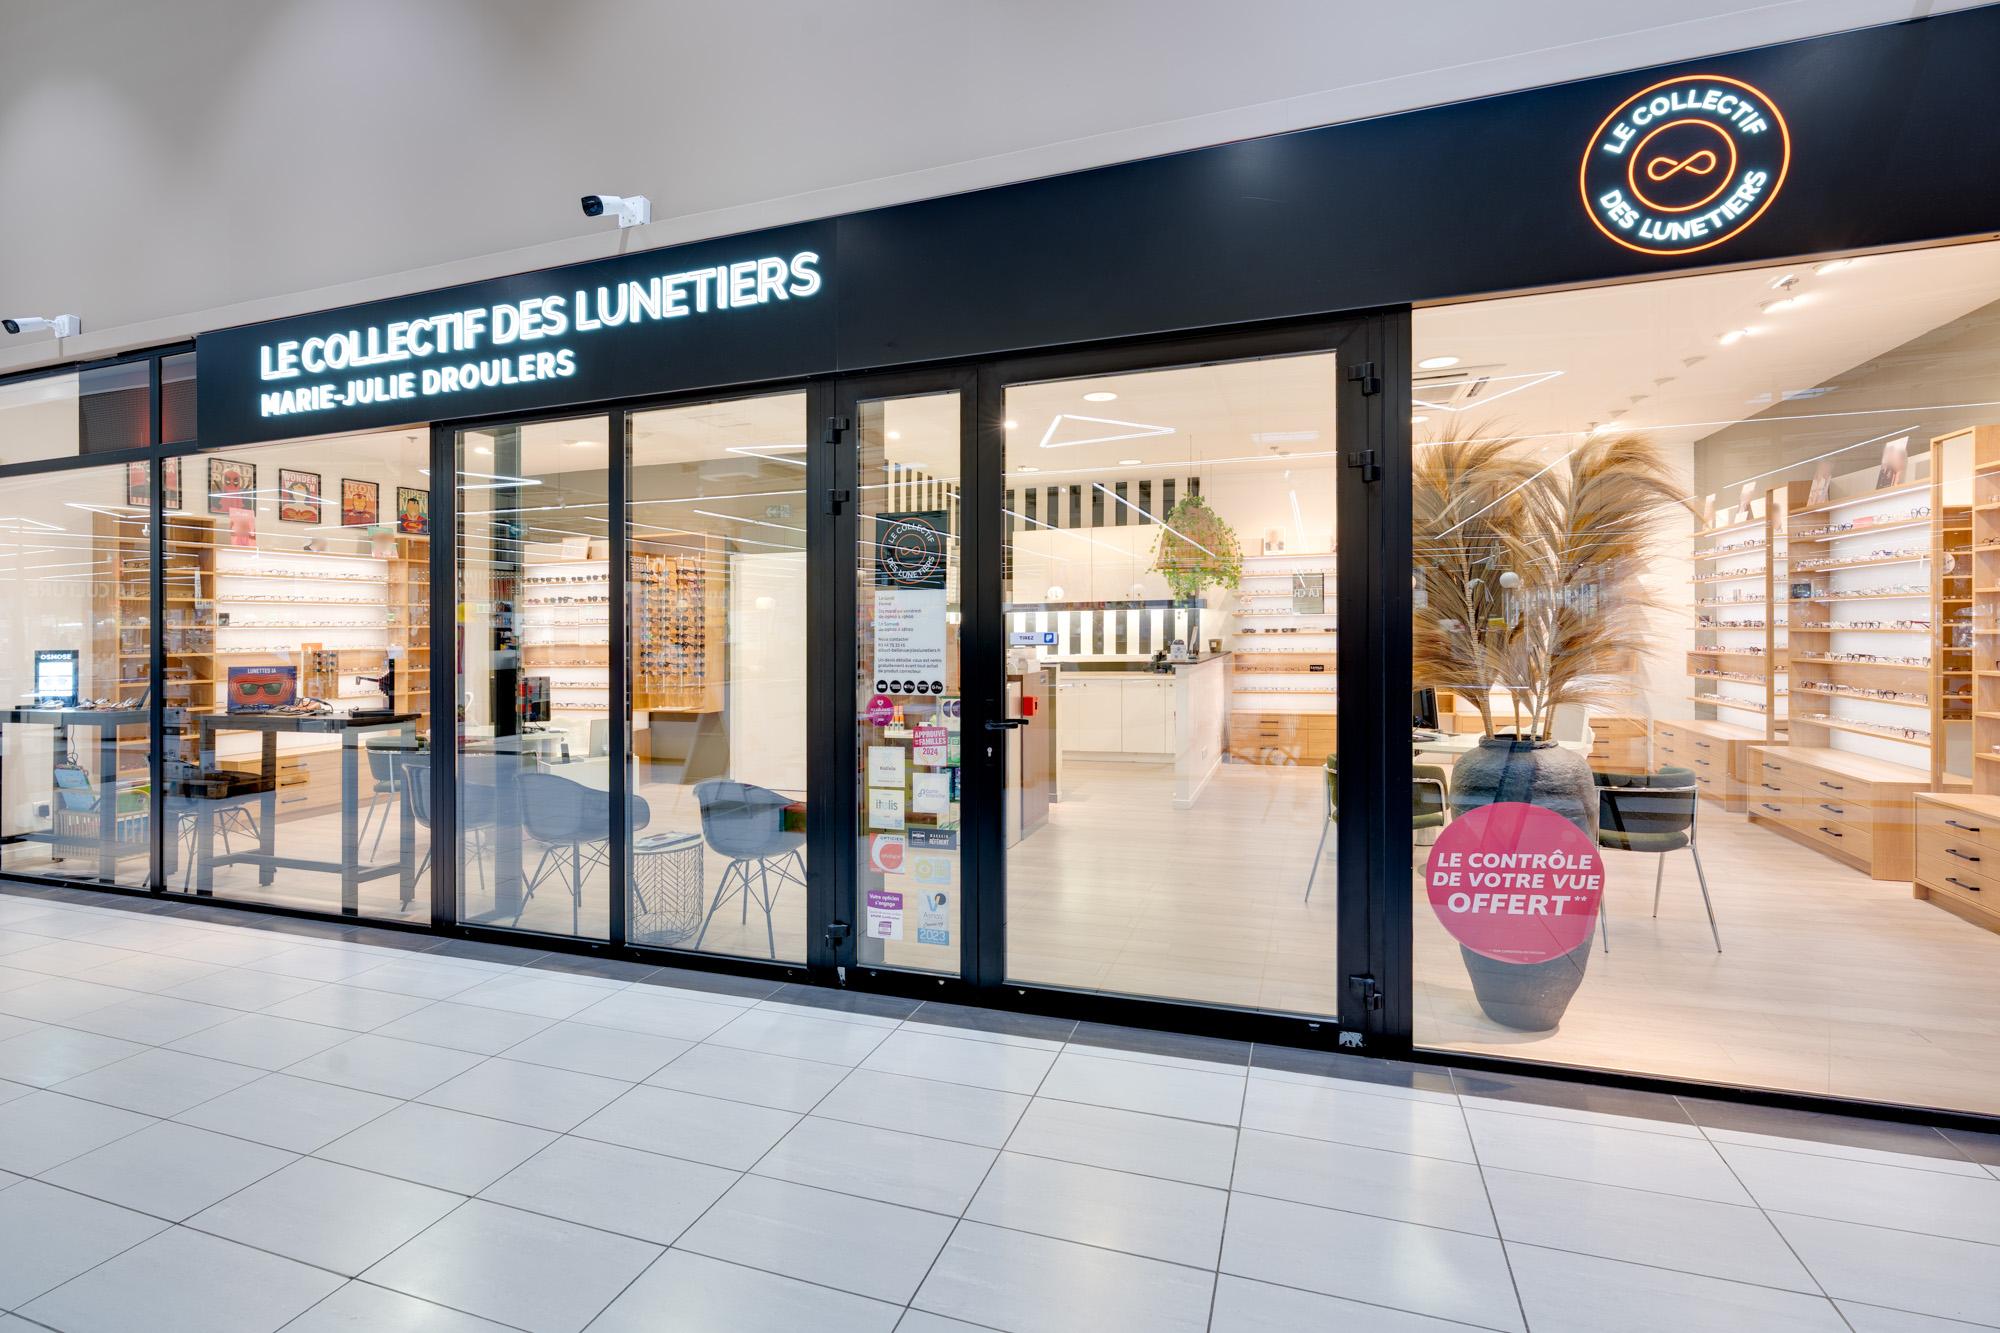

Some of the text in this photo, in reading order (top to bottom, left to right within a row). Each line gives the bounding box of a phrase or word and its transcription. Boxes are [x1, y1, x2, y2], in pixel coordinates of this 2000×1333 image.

[1603, 89, 1768, 154] LE COLLECTIF
[1599, 170, 1768, 241] DES LUNETIERS
[260, 251, 823, 381] LE COLLECTIF DES LUNETIERS
[260, 348, 577, 418] MARIE-JULIE DROULERS
[282, 470, 317, 484] WONDER
[399, 489, 427, 499] SUPER
[888, 523, 935, 544] LE COLLECTIF
[886, 555, 935, 578] DES LUNETIERS
[922, 747, 938, 756] 2024
[1437, 849, 1593, 870] LE CONTRÔLE
[1432, 872, 1601, 890] DE VOTRE VUE
[920, 930, 946, 941] 2023
